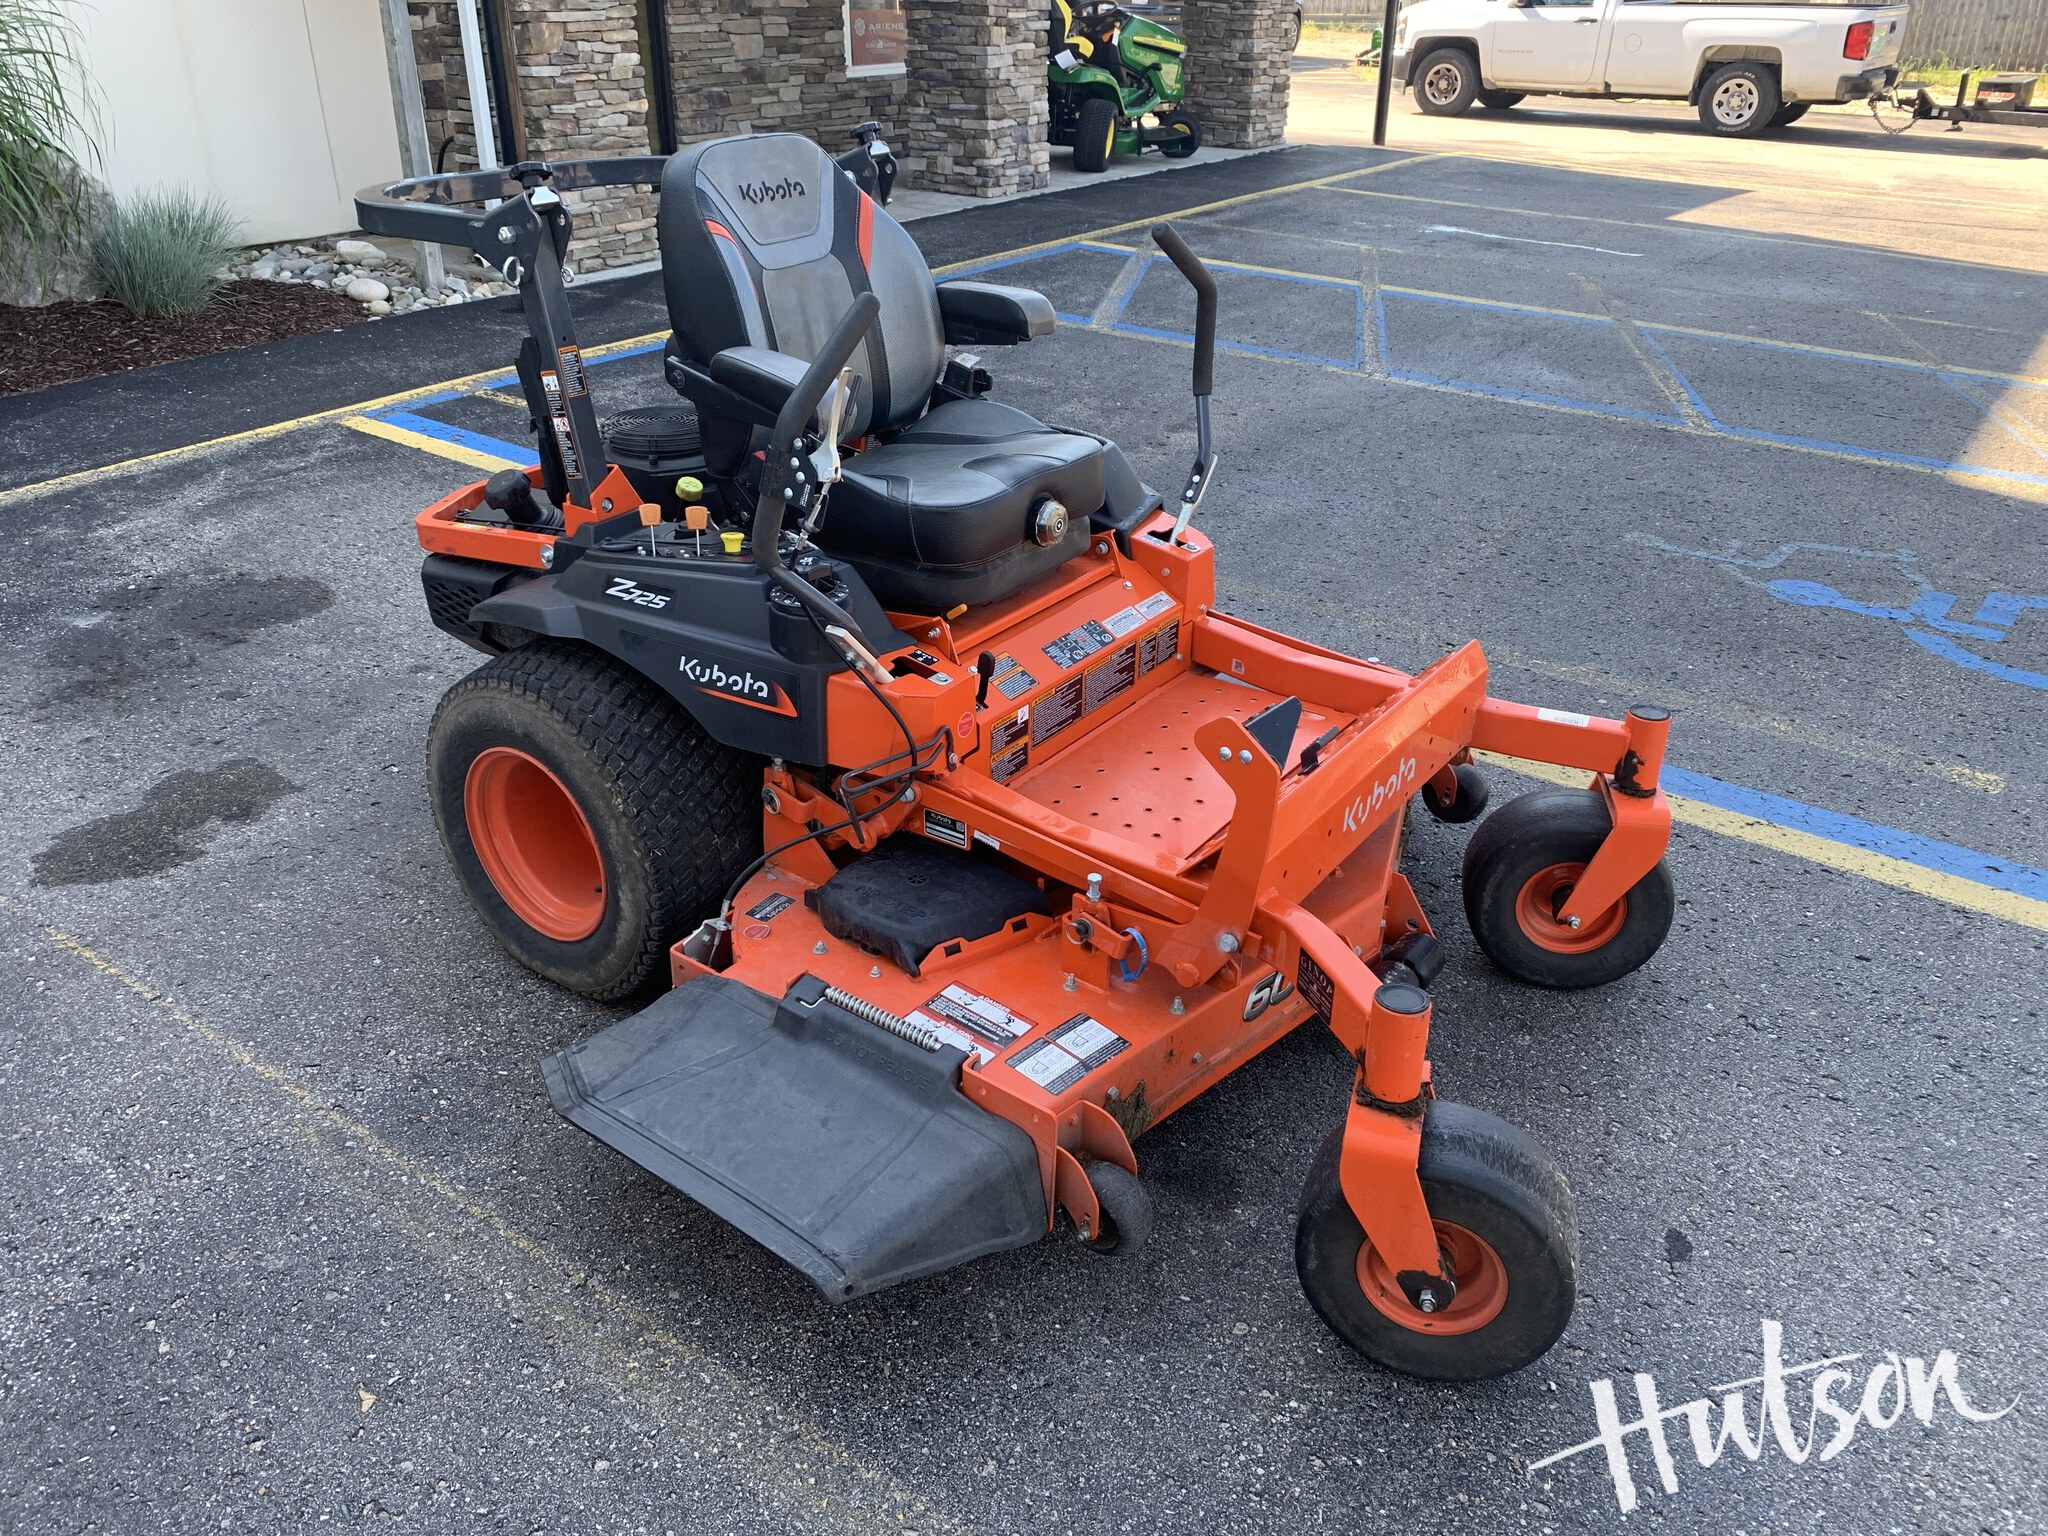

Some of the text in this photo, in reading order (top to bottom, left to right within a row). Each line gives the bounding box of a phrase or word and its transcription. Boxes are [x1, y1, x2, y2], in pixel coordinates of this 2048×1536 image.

[868, 22, 905, 34] ARIENS
[738, 177, 806, 204] Kubota
[605, 577, 672, 609] Z725
[679, 656, 770, 698] Kubota
[1343, 757, 1416, 832] Kubota
[984, 996, 1011, 1013] DANGER
[824, 1027, 845, 1046] DO
[945, 1022, 974, 1041] PELIGRO
